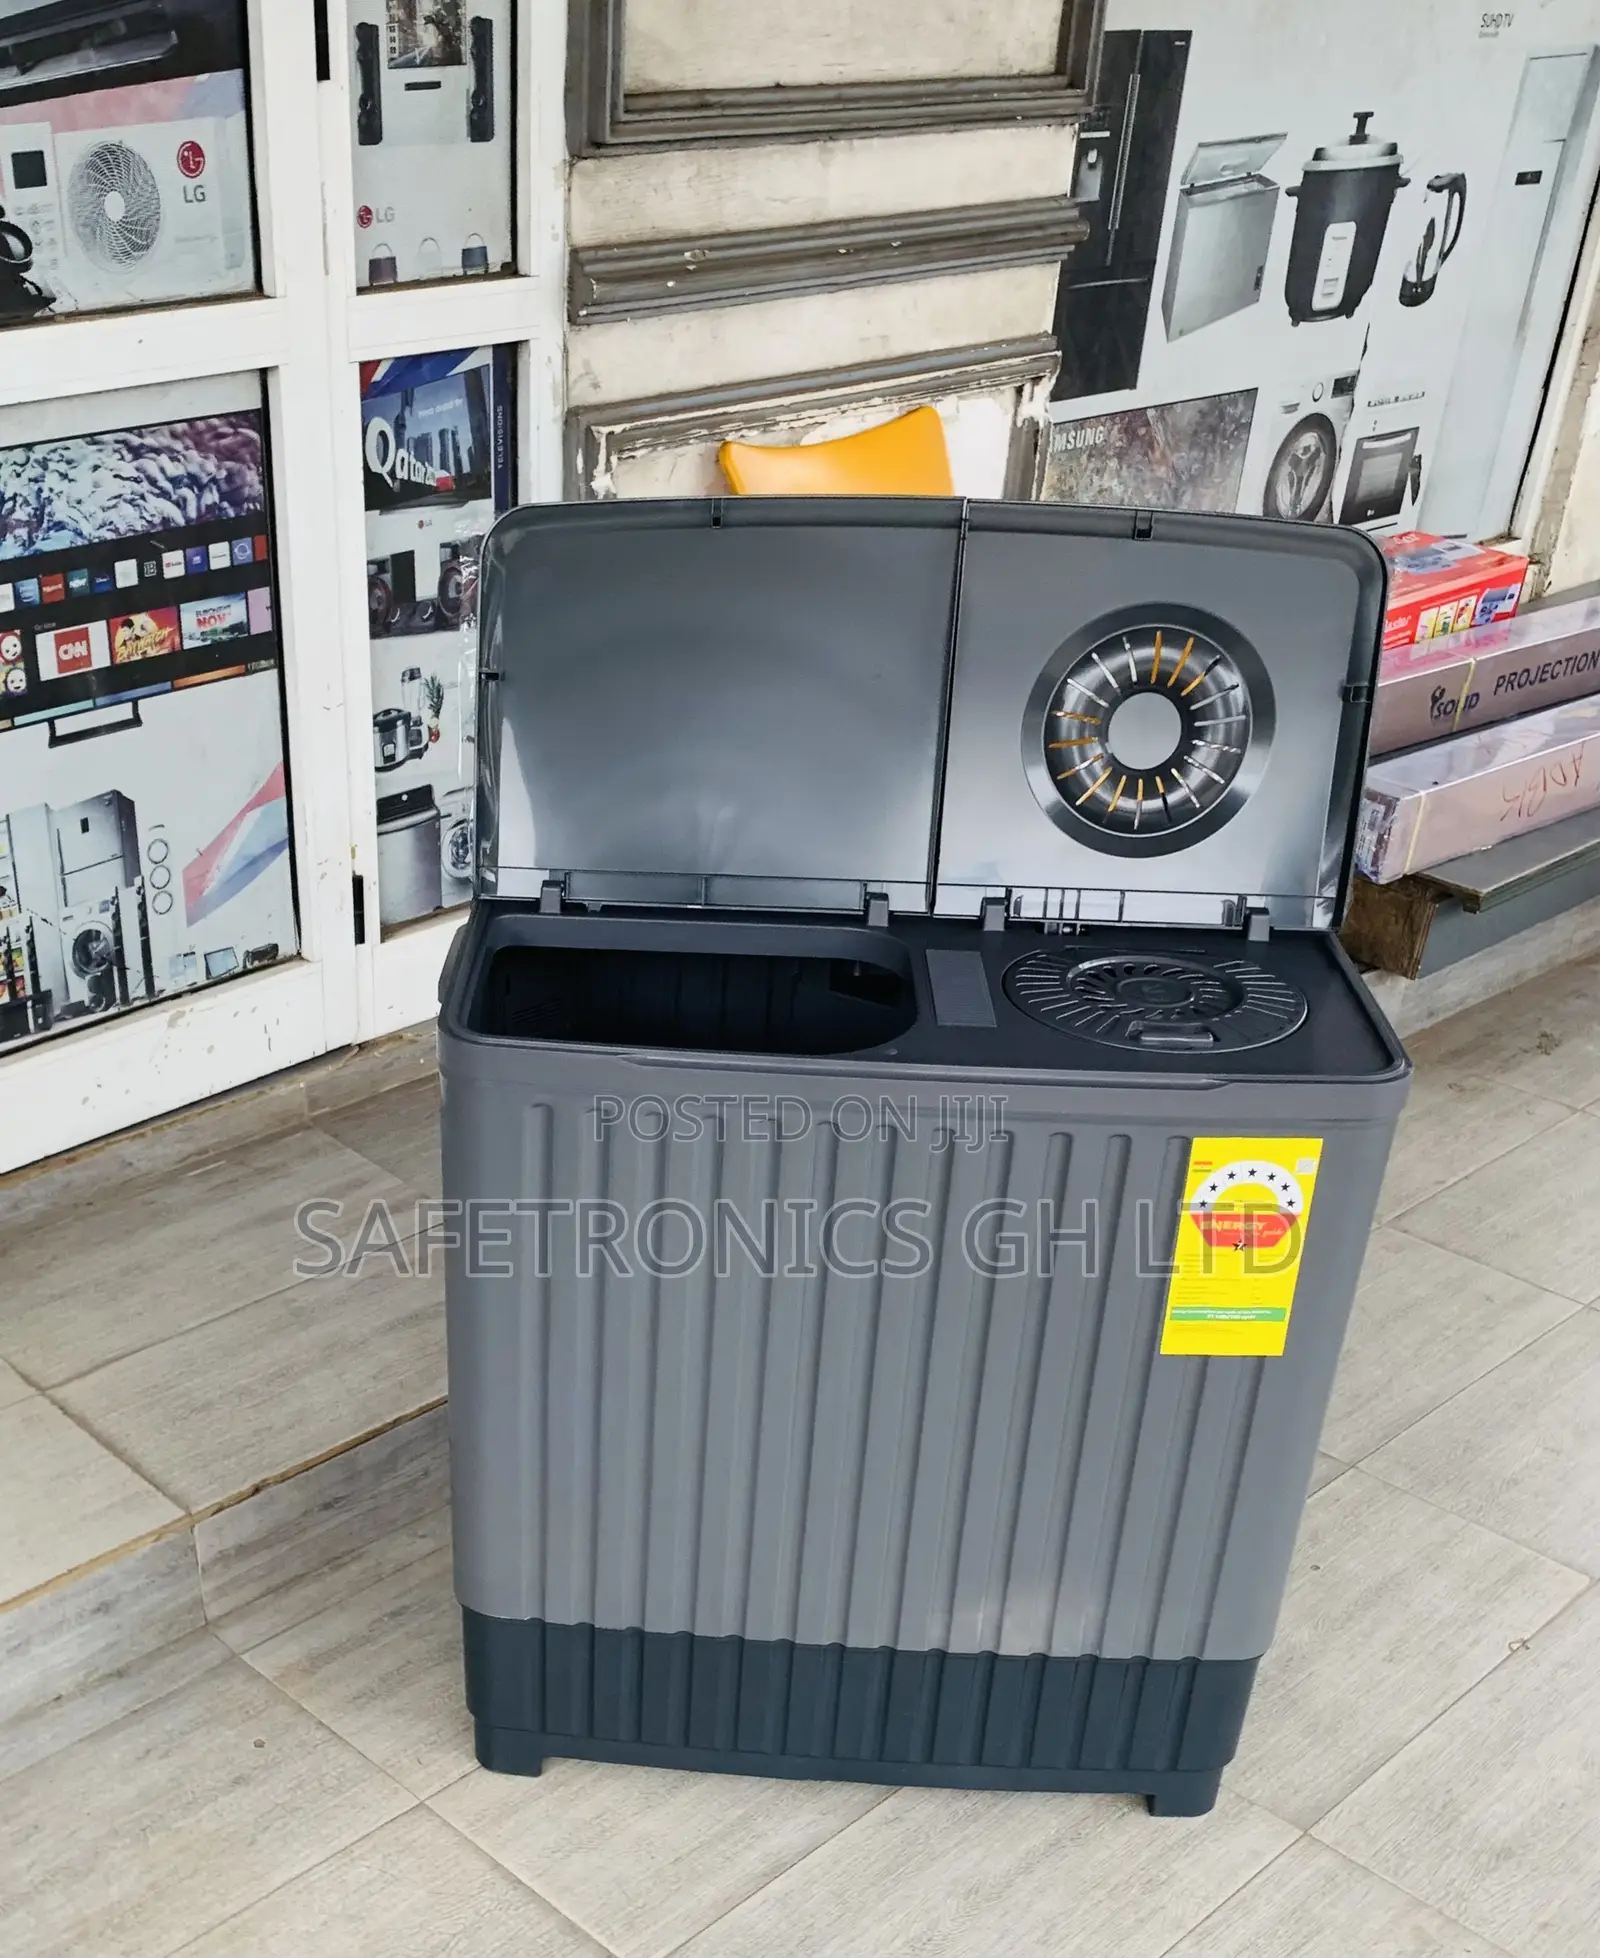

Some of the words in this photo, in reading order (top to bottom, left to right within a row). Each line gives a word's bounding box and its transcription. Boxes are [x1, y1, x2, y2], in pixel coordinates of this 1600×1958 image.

[183, 184, 206, 203] LG
[376, 206, 396, 223] LG
[496, 405, 504, 469] TELEVISIONS
[1053, 425, 1105, 453] MSUNG
[59, 640, 88, 661] CNN
[1493, 649, 1600, 696] PROJECTION
[1200, 1221, 1268, 1232] ENERGY
